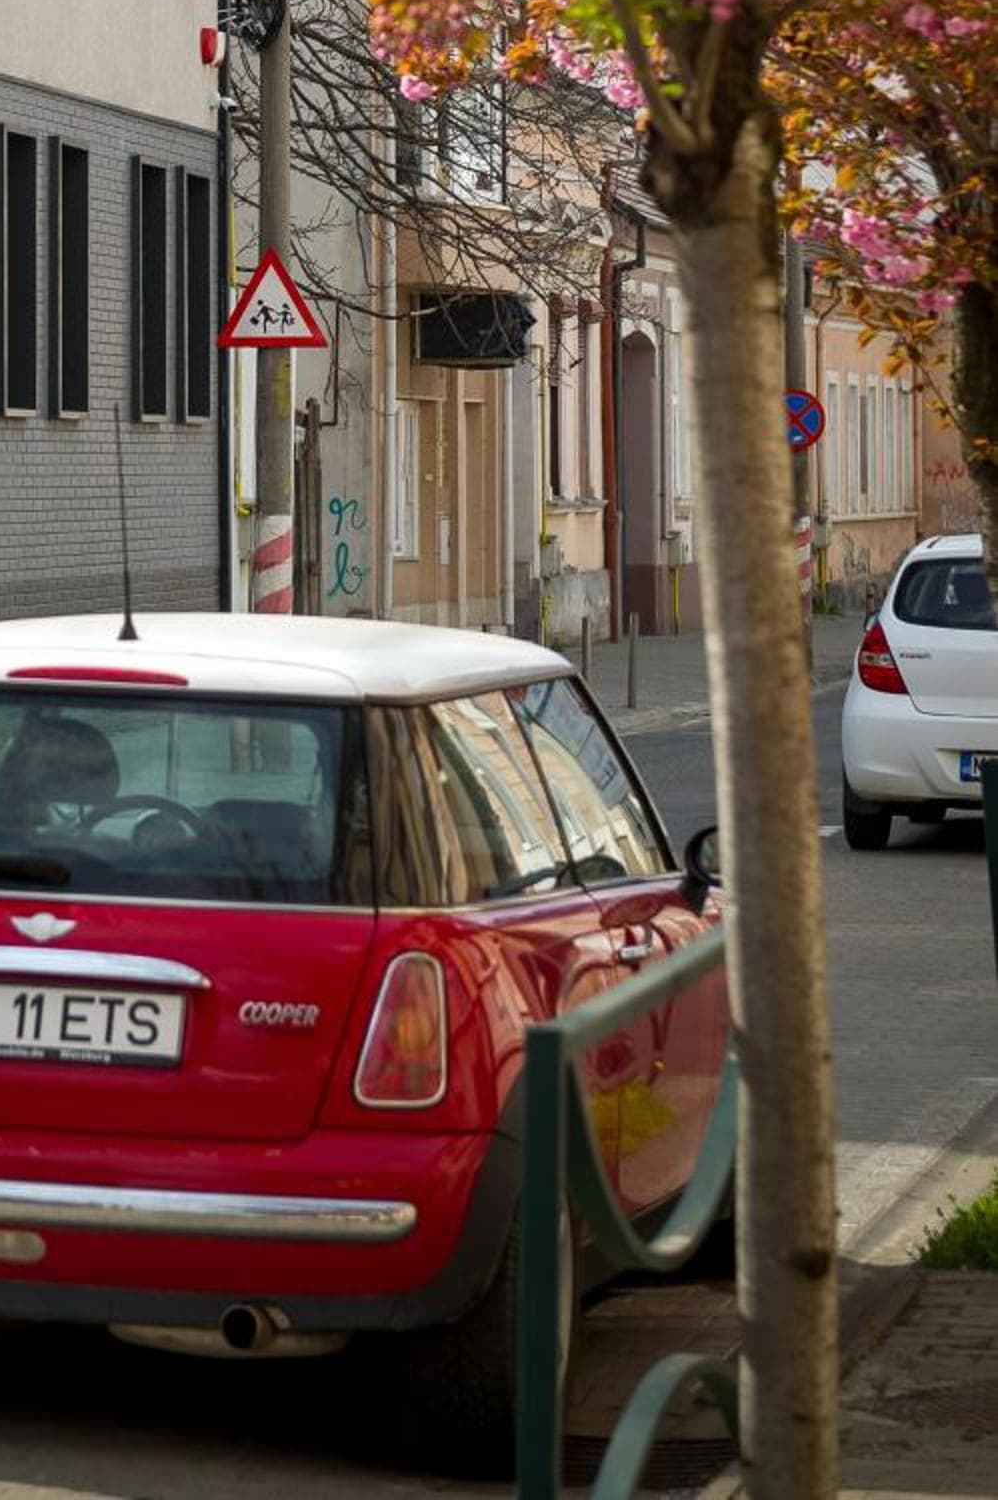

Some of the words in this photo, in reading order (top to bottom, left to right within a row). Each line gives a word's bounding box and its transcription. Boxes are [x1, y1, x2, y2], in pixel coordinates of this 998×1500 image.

[12, 993, 45, 1039] 11
[59, 995, 161, 1046] ETS
[239, 1000, 320, 1027] COOPER
